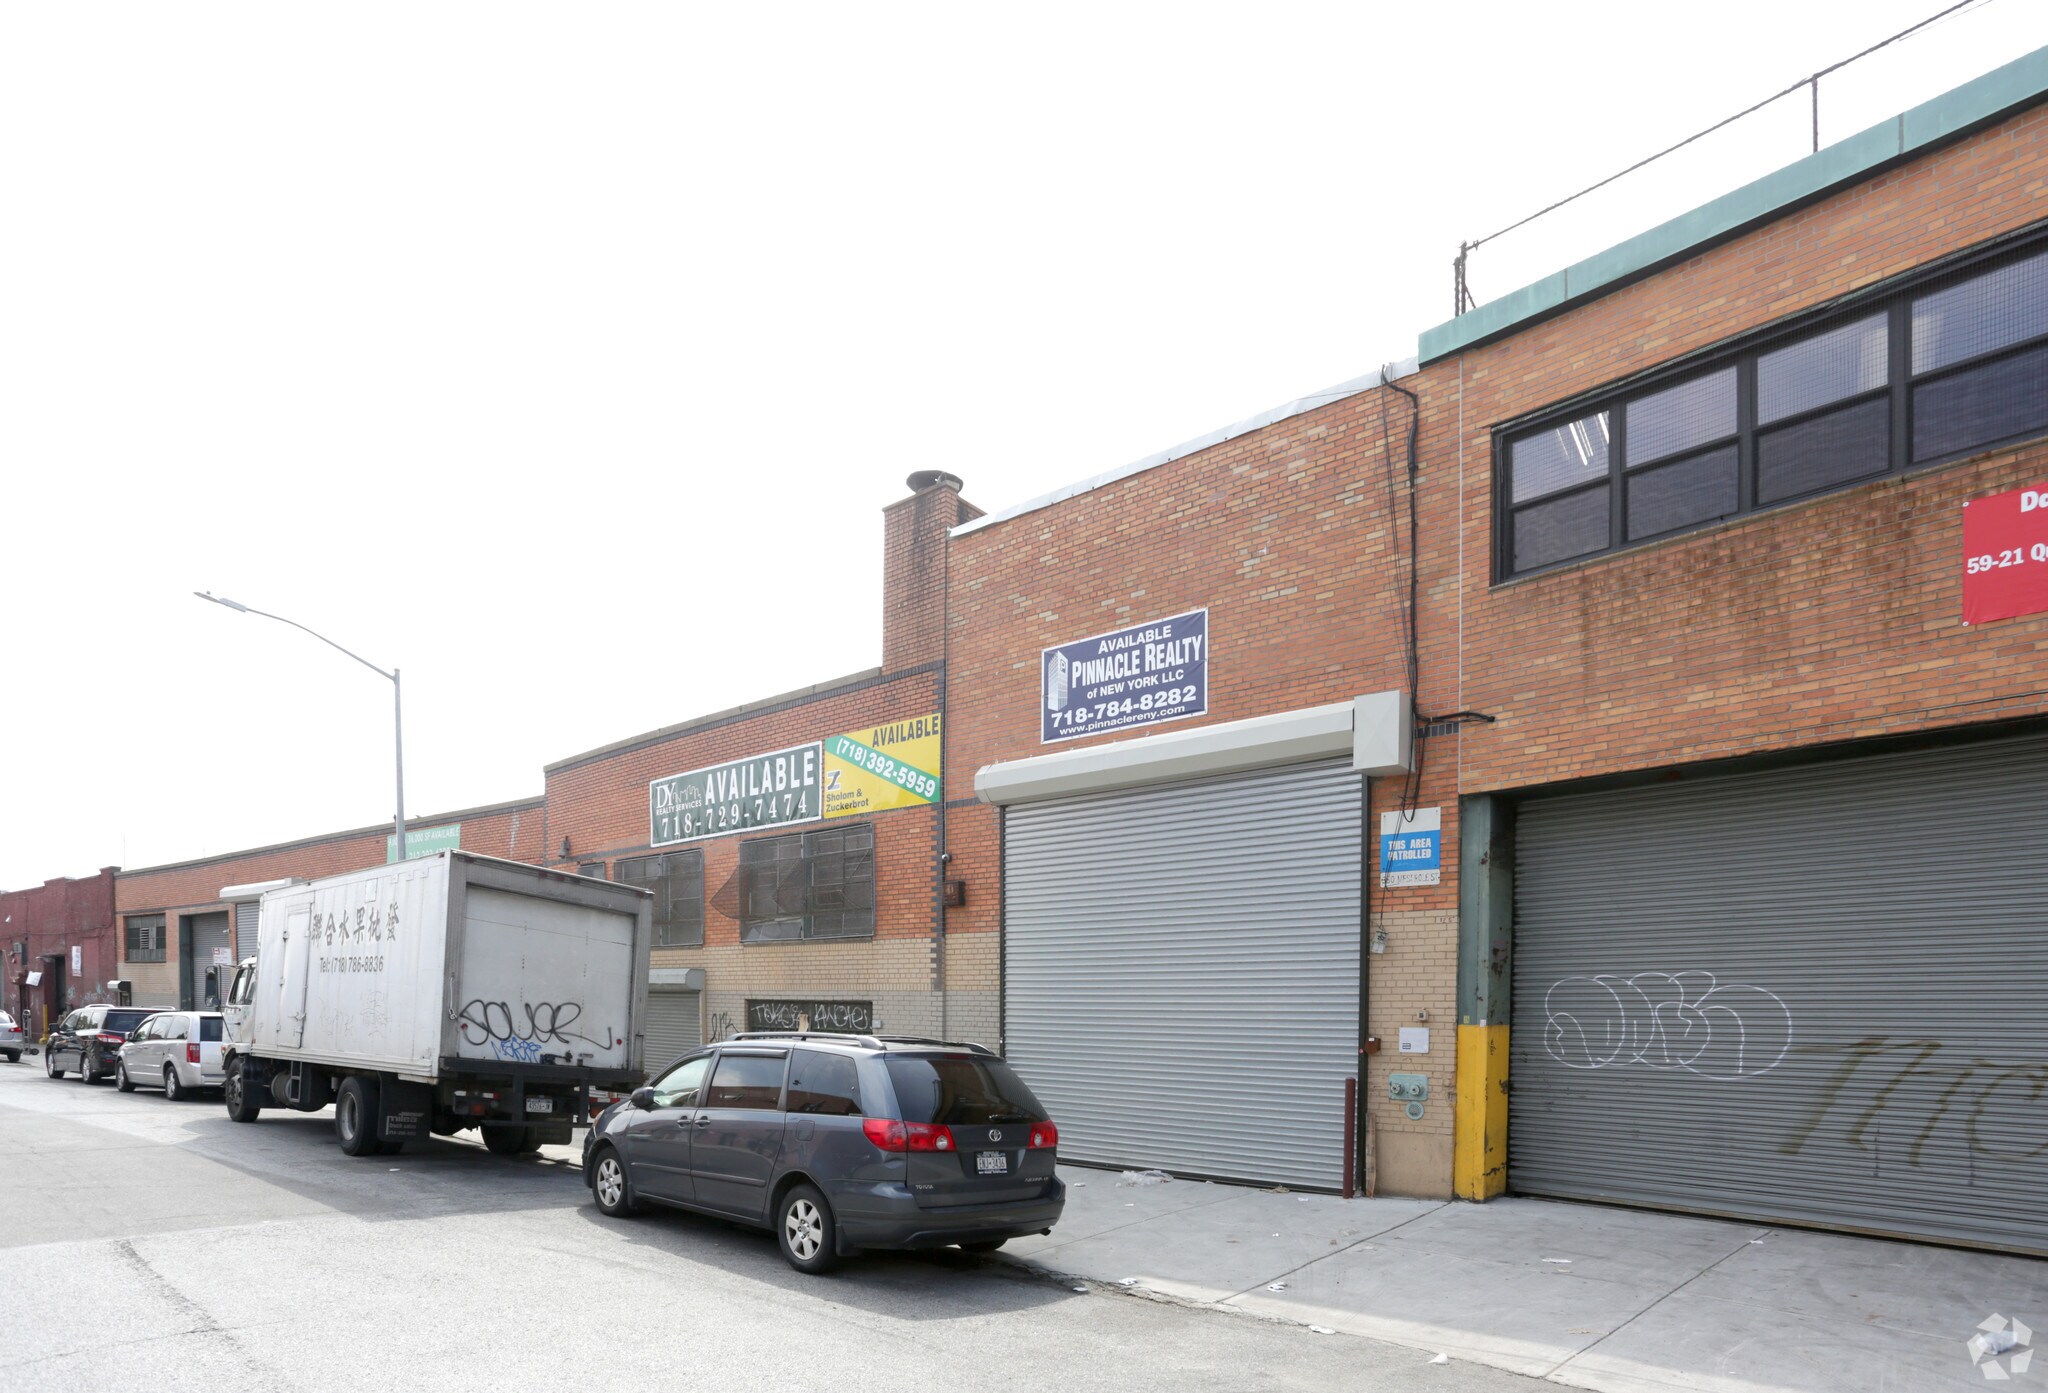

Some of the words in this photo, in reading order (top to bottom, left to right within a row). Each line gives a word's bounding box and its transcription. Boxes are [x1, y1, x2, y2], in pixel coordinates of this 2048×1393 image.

[1967, 547, 2024, 575] 59-21
[2030, 543, 2048, 563] Q
[1098, 625, 1172, 655] AVAILABLE
[1071, 649, 1140, 689] PINNACLE
[1144, 634, 1203, 673] REALTY
[1087, 688, 1098, 700] of
[1100, 682, 1125, 697] NEW
[1127, 675, 1158, 692] YORK
[1162, 669, 1185, 684] LLC
[1051, 685, 1197, 728] 718-784-8282
[1059, 705, 1185, 736] www.pinnaclereny.com
[872, 715, 939, 748] AVAILABLE
[705, 750, 815, 805] AVAILABLE
[836, 738, 867, 766] (718)
[866, 752, 936, 798] 392-5959
[656, 782, 677, 809] DY
[656, 805, 675, 815] REALTY
[675, 799, 702, 812] SERVICES
[826, 790, 855, 803] Sholom
[856, 788, 863, 797] &
[826, 798, 869, 813] Zuckerbrot
[662, 790, 808, 838] 718-729-7474
[431, 827, 460, 840] AVAILABLE
[1388, 840, 1406, 850] THIS
[1410, 838, 1431, 849] AREA
[1388, 848, 1432, 861] PATROLLED
[319, 957, 330, 973] Tel:
[331, 956, 347, 974] (718)
[348, 955, 384, 973] 786-8836
